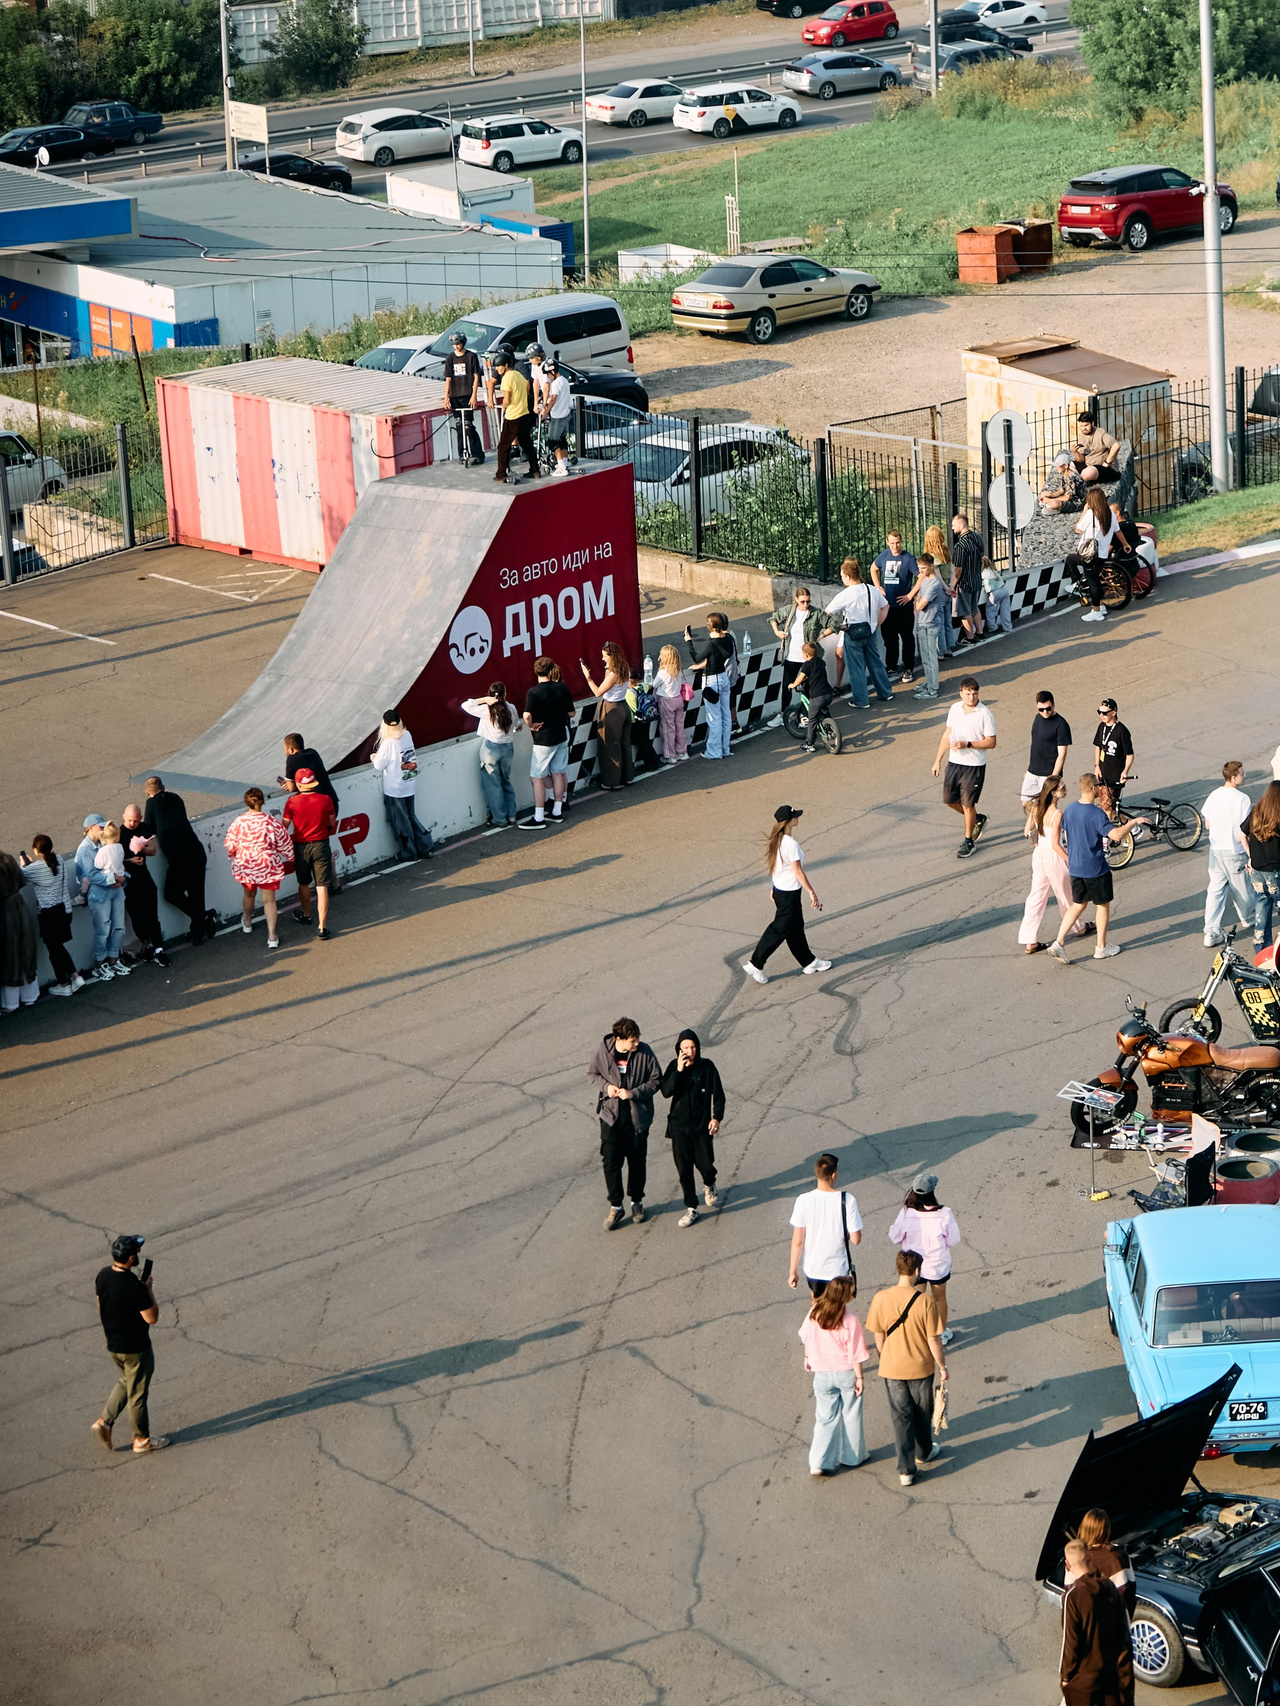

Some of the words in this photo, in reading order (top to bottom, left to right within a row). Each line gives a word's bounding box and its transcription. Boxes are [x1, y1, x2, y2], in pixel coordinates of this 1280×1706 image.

[500, 567, 519, 589] За
[522, 558, 558, 582] авто
[562, 548, 590, 572] иди
[594, 542, 613, 561] на
[502, 574, 616, 658] дром
